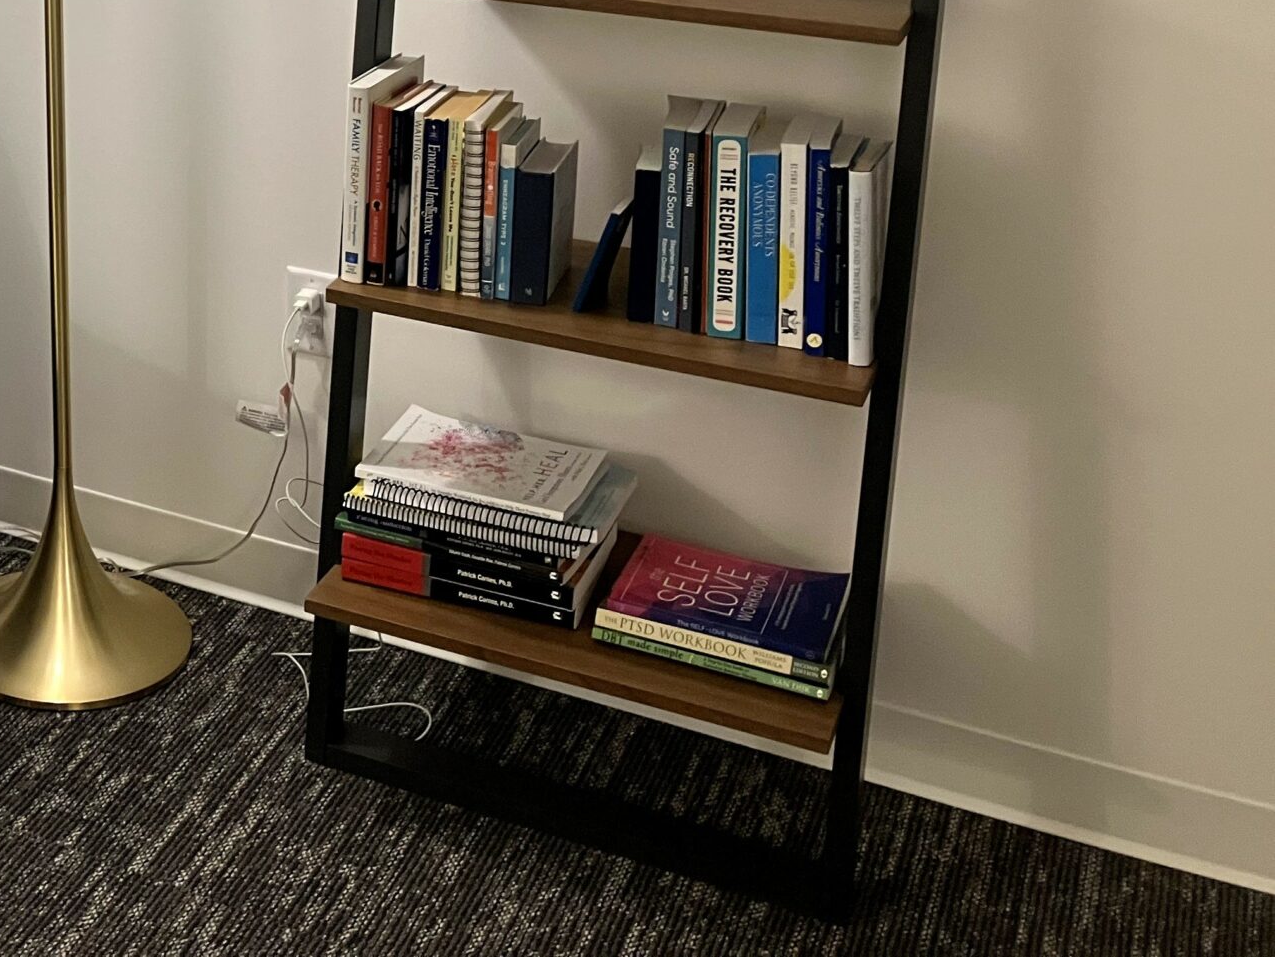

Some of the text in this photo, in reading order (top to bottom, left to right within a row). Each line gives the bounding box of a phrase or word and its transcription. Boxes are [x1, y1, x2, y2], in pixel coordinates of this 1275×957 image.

[351, 118, 361, 153] FAMILY
[413, 119, 422, 161] WAITING
[350, 156, 360, 197] THERAPY
[425, 144, 441, 190] Emotional
[666, 146, 680, 228] Safe and Sound
[685, 152, 695, 208] RECONNECTION
[421, 191, 438, 236] Intelligence
[717, 168, 737, 303] THE RECOVERY BOOK
[752, 181, 764, 248] ANONYMOUS
[532, 450, 569, 477] HEAL
[456, 568, 477, 580] Patrick
[458, 590, 478, 601] Patrick
[656, 555, 710, 607] SELF
[698, 565, 751, 617] LOVE
[736, 573, 771, 623] WORKBOOK
[601, 630, 684, 660] DBT made simple
[619, 617, 655, 635] PTSD
[659, 626, 748, 660] WORKBOOK
